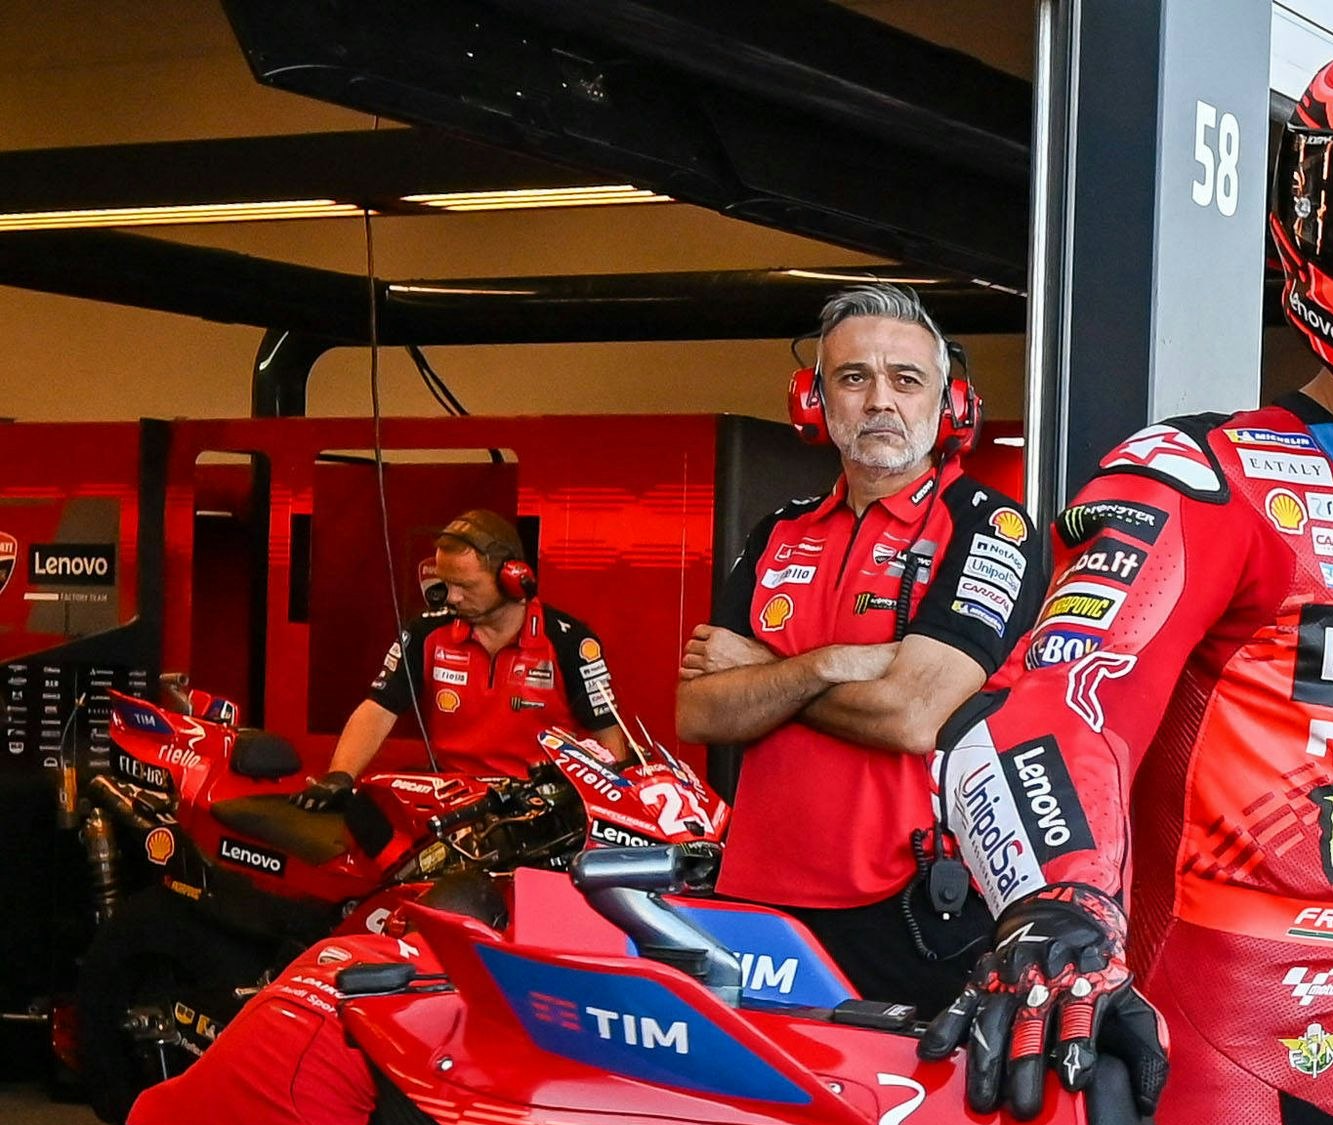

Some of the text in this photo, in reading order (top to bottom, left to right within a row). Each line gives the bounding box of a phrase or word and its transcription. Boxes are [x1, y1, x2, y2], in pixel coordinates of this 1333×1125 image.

[1192, 101, 1240, 216] 58
[1254, 431, 1309, 446] MICHELIN
[1250, 457, 1322, 477] EATALY
[34, 551, 109, 576] Lenovo
[134, 714, 155, 727] TIM
[158, 744, 200, 768] riello
[567, 762, 622, 802] riello
[1013, 746, 1070, 847] Lenovo
[962, 762, 1028, 902] UnipolSai
[221, 841, 281, 871] Lenovo
[587, 1006, 689, 1054] TIM
